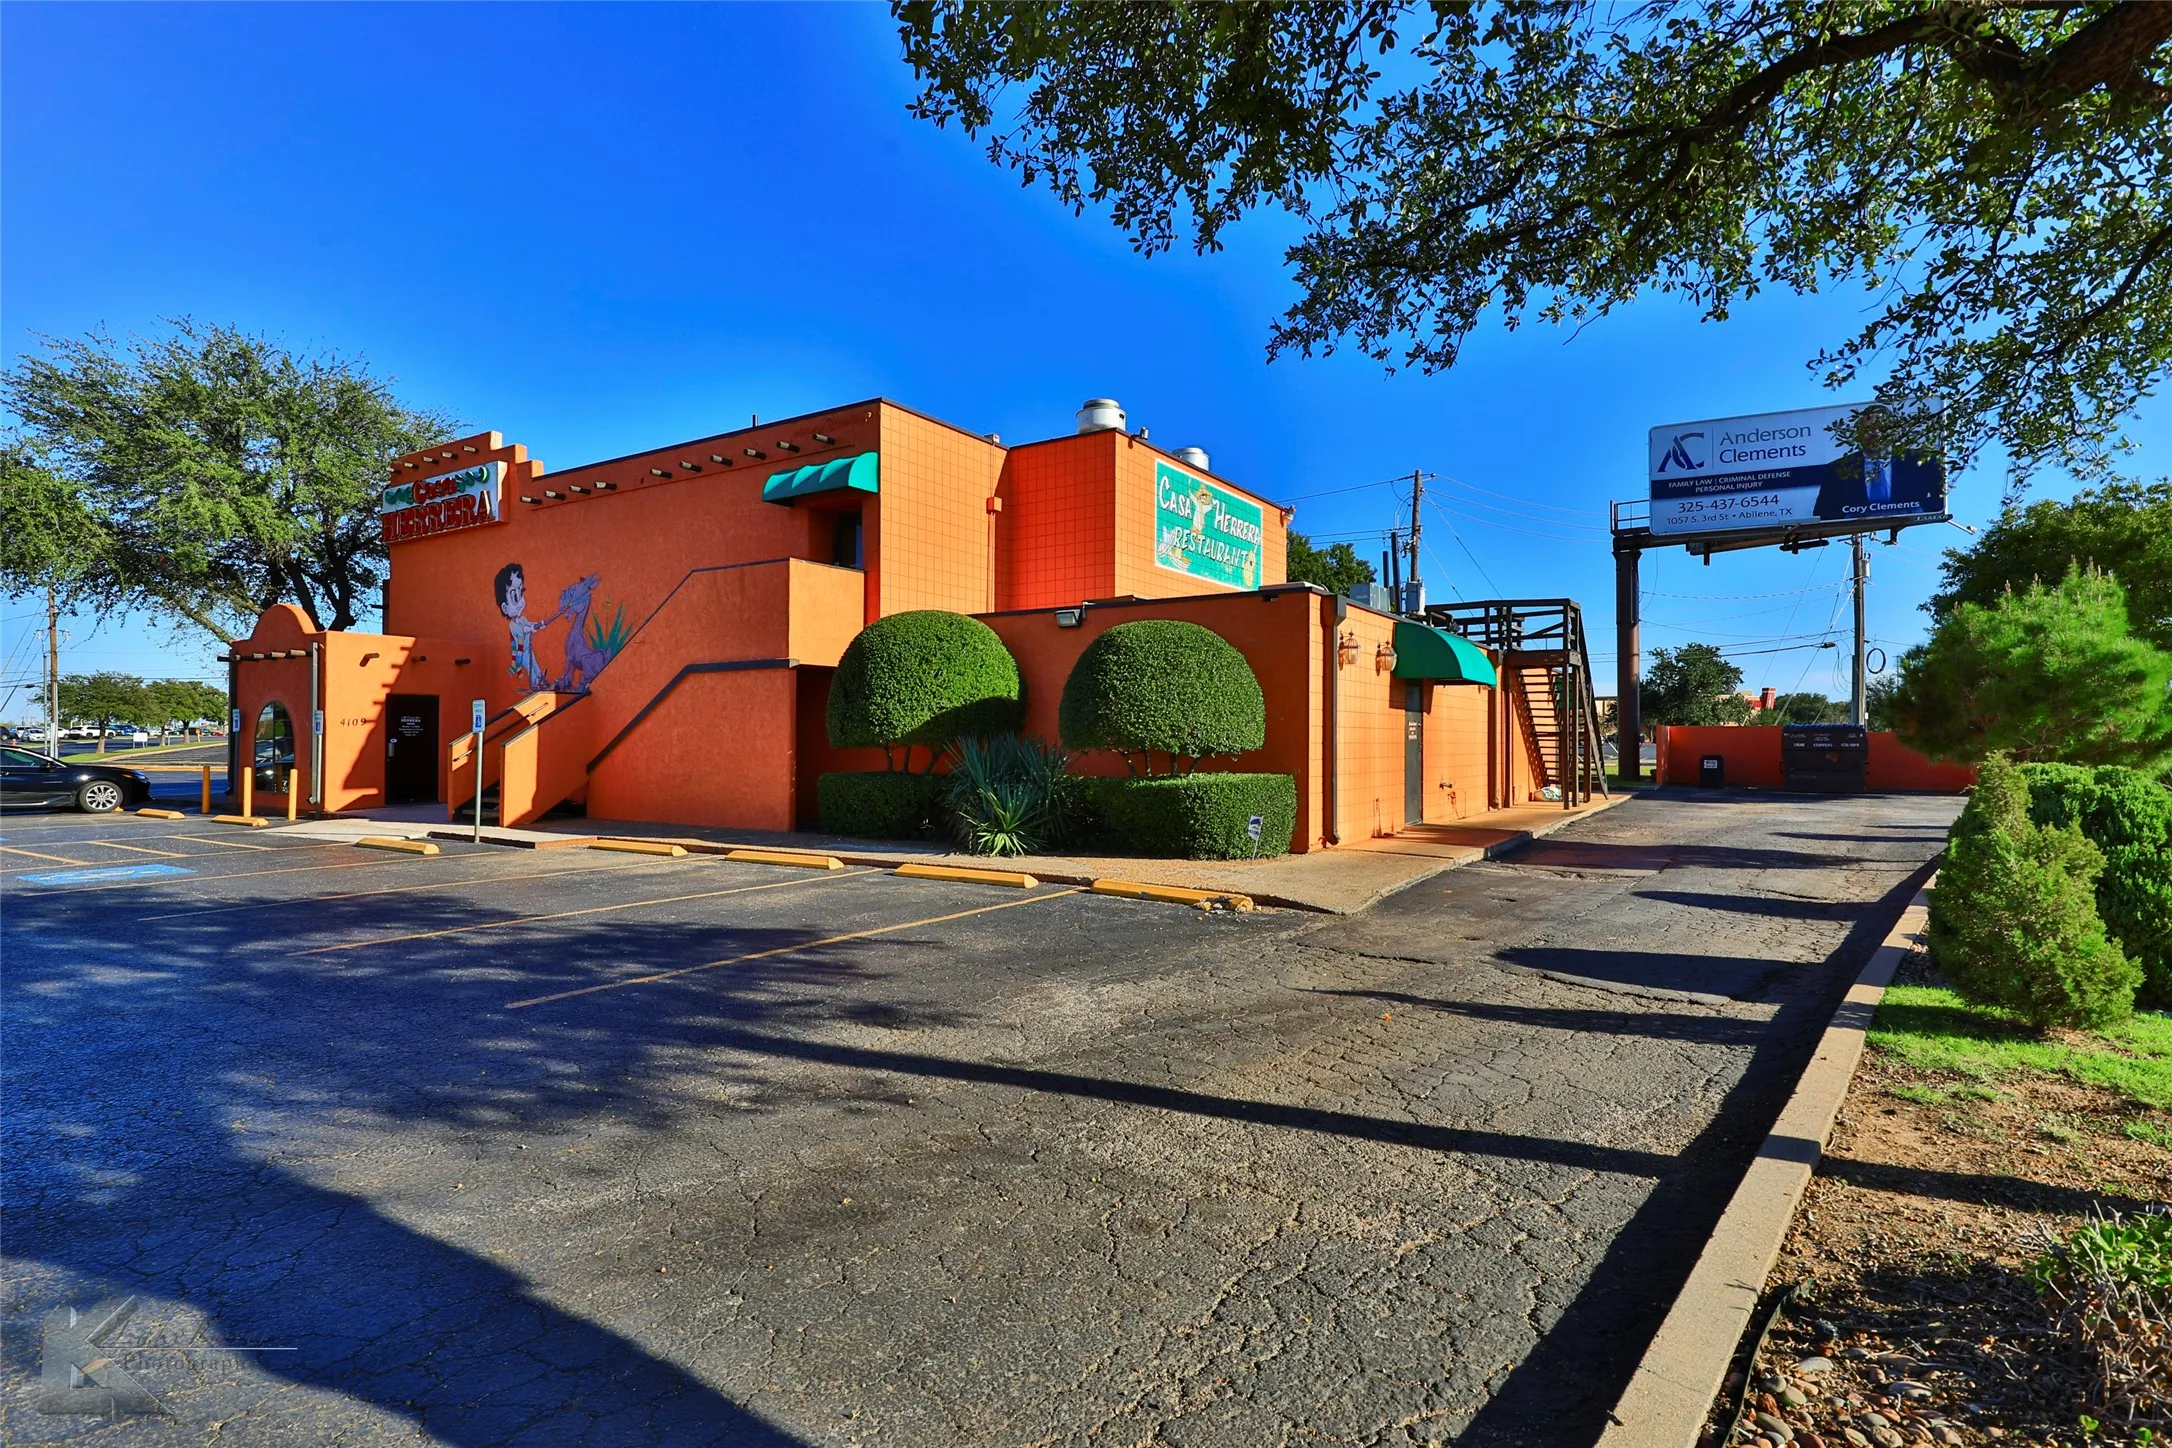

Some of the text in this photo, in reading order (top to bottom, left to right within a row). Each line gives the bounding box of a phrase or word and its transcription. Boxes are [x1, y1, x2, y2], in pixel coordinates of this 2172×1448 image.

[1720, 426, 1811, 446] Anderson
[1719, 444, 1806, 464] Clements
[1668, 471, 1791, 489] FAMILY LAW CRIMINAL DEFENSE
[1695, 481, 1763, 493] PERSONAL INJURY
[412, 477, 457, 504] Casa
[1159, 475, 1260, 545] CASA HERRERA
[1678, 494, 1780, 513] 325-437-6544
[1842, 501, 1920, 514] Cory Clements
[382, 490, 496, 540] HERRERA
[1667, 516, 1688, 525] 1057
[1702, 513, 1717, 522] 3rd
[1719, 513, 1728, 521] St
[1738, 510, 1778, 519] Abilene,
[1779, 507, 1792, 516] TX
[1173, 526, 1247, 568] RESTAURANT
[340, 717, 367, 726] 4109
